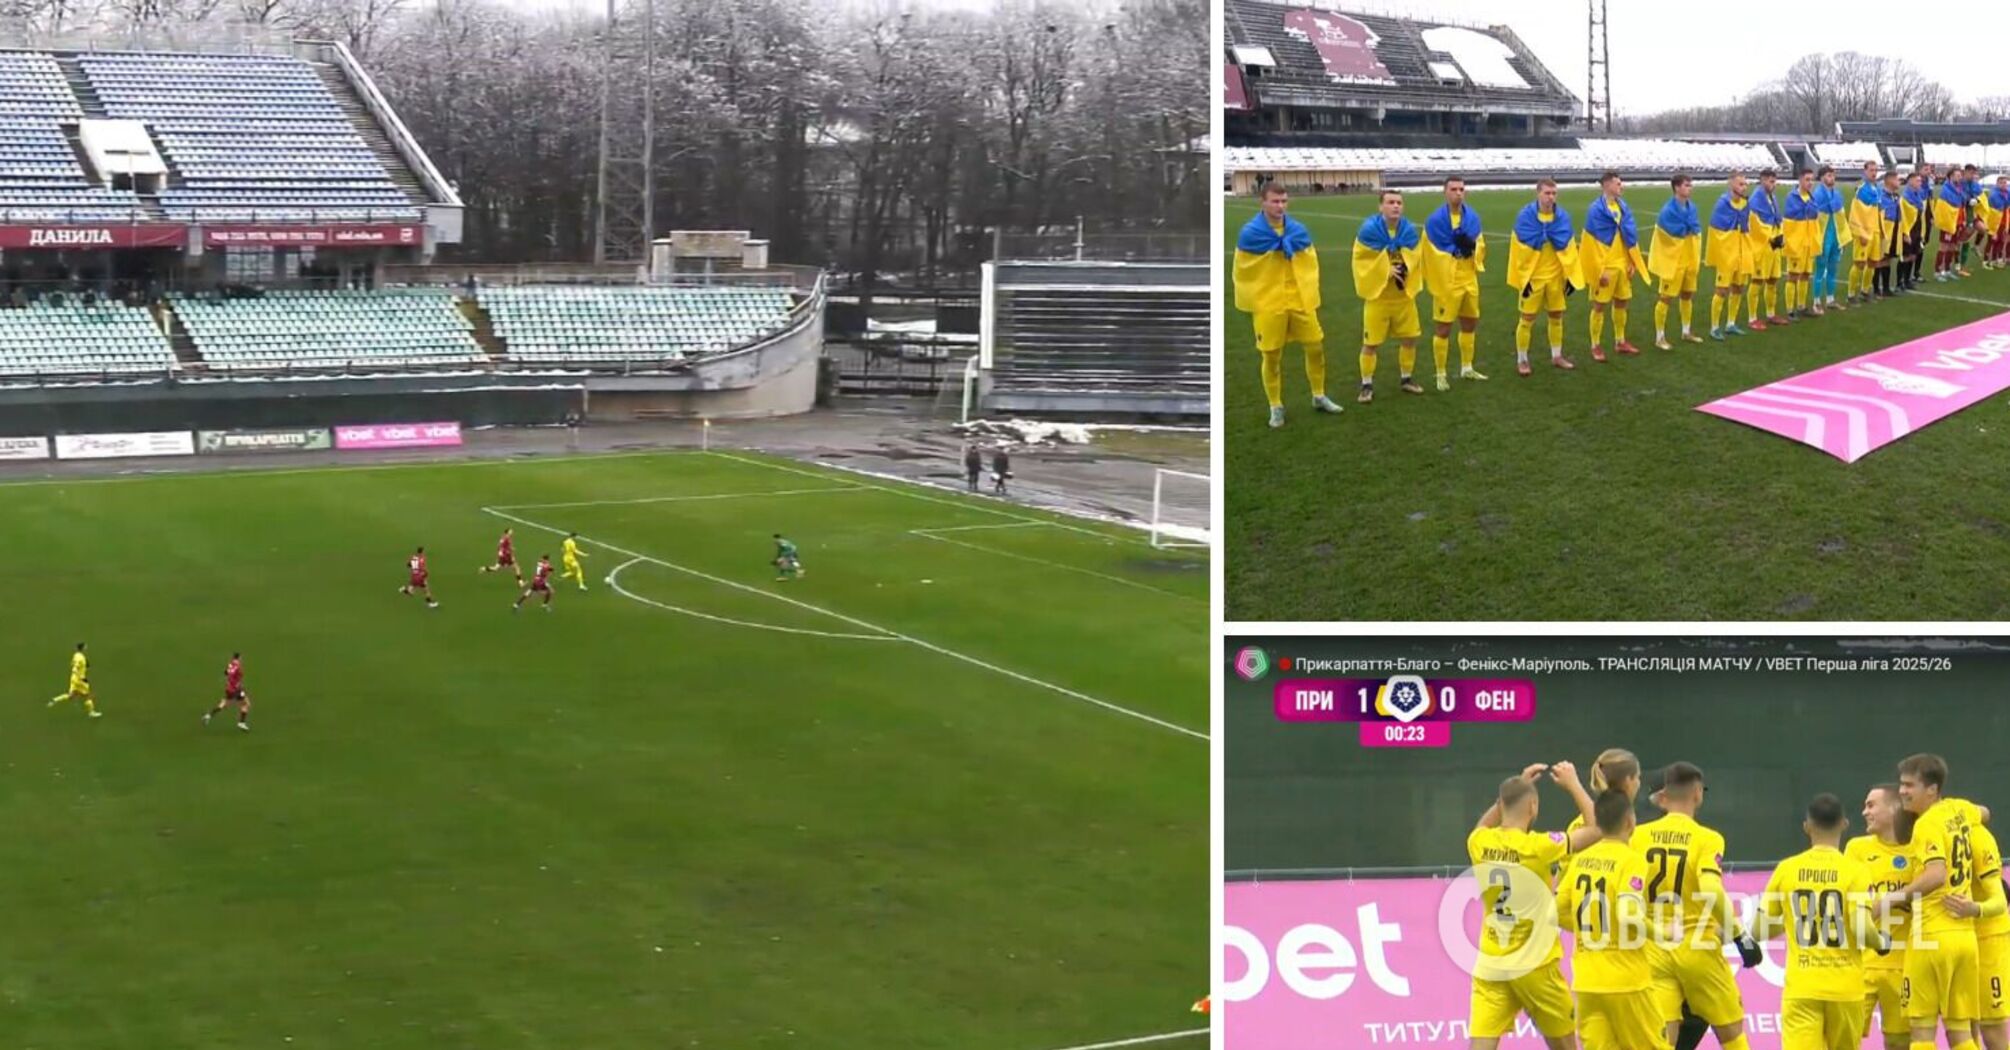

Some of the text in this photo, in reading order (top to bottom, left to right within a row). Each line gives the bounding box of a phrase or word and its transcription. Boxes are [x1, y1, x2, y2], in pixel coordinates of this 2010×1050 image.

[29, 229, 113, 246] ДАНИЛА
[1488, 868, 1516, 922] 2
[1576, 873, 1609, 933] 21
[1646, 847, 1688, 904] 27
[1792, 889, 1847, 948] 88
